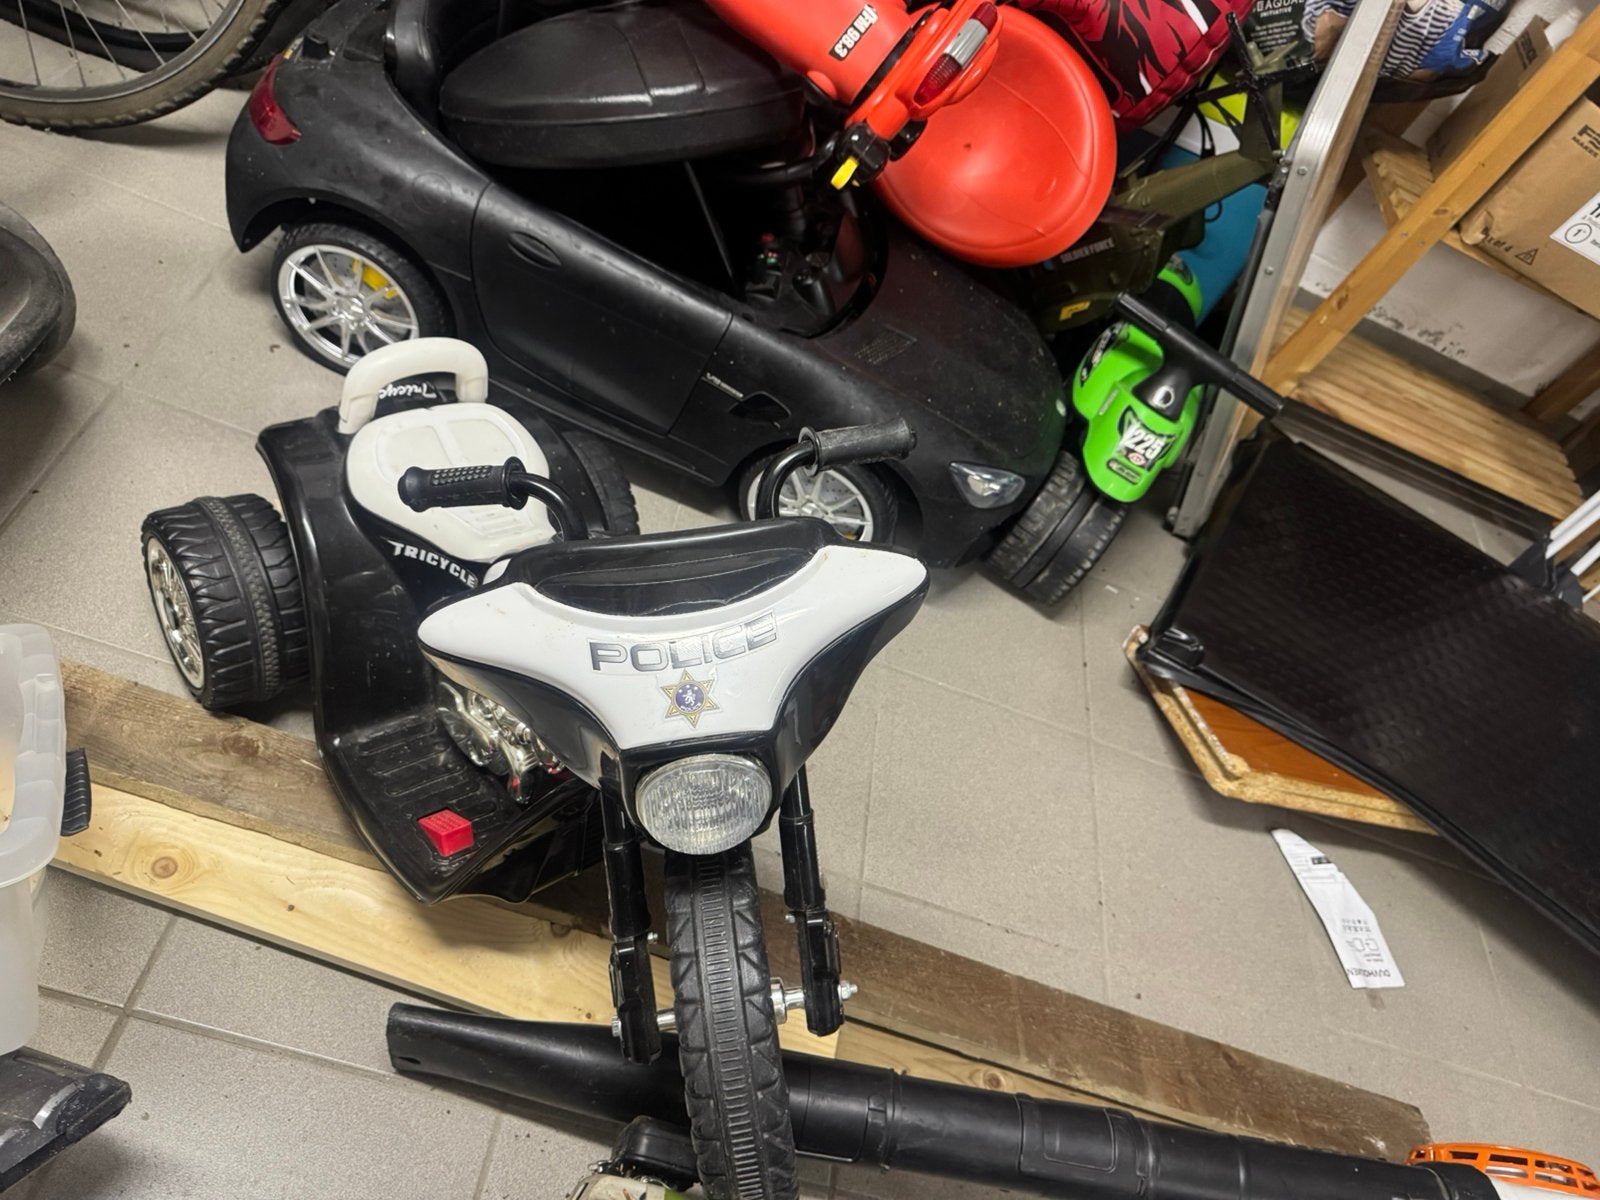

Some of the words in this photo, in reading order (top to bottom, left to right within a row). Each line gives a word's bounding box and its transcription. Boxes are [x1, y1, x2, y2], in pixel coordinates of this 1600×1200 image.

[834, 27, 860, 57] 98.3
[387, 540, 477, 589] TRICYCLE
[589, 611, 777, 672] POLICE
